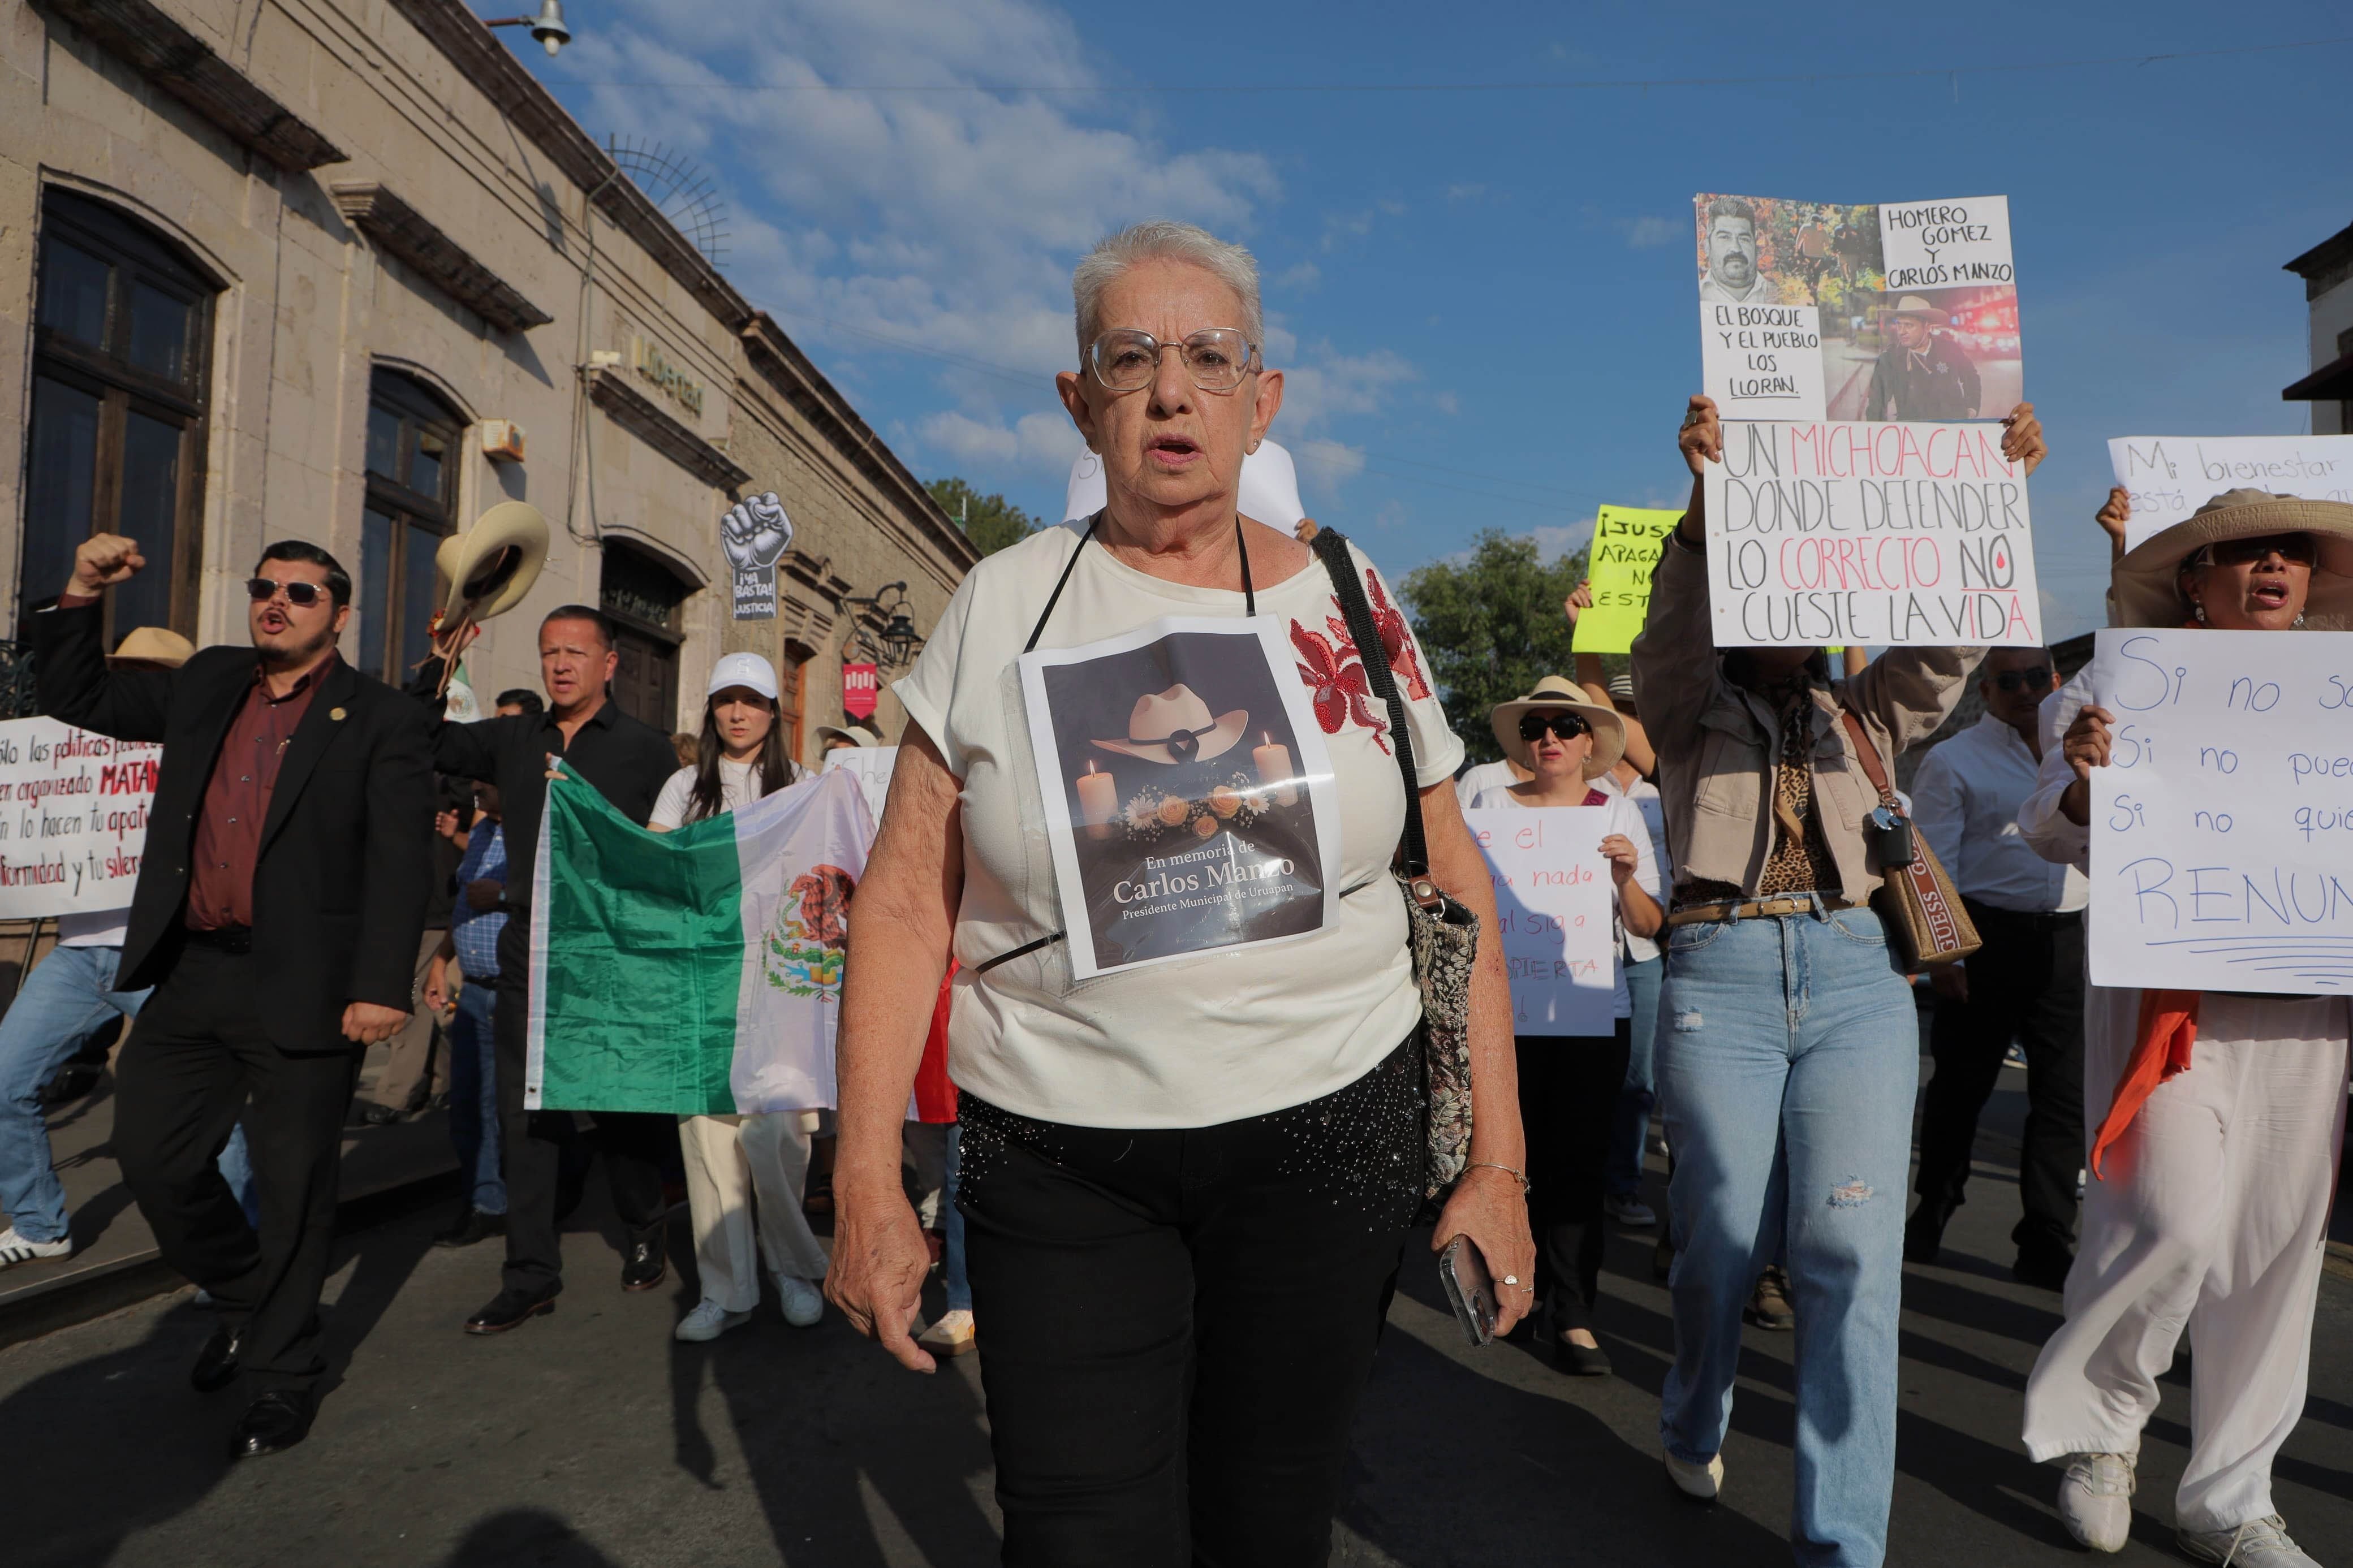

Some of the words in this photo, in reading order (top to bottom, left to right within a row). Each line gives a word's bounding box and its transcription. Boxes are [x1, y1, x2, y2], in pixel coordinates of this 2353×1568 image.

[1889, 206, 1967, 230] HOMERO
[1922, 225, 1992, 245] GOMEZ
[1925, 248, 1940, 264] Y
[1889, 265, 1947, 288] CARLOS
[1954, 262, 2012, 282] MANZO
[1716, 305, 1734, 326] EL
[1738, 307, 1803, 328] BOSQUE
[1719, 332, 1732, 349] Y
[1738, 331, 1759, 348] EL
[1764, 332, 1818, 348] PUEBLO
[1748, 353, 1777, 373] LOS
[1730, 374, 1799, 396] LLORAN.
[1722, 423, 1779, 478] UN
[1791, 425, 2014, 478] MICHOACAN
[2127, 441, 2177, 480] Mi
[2196, 443, 2341, 481] bienestar
[1725, 478, 1850, 533] DONDE
[1860, 478, 2024, 532] DEFENDER
[1727, 539, 1766, 590] LO
[1780, 537, 1941, 590] CORRECTO
[1959, 533, 2014, 589] NO
[735, 582, 772, 598] BASTA!
[736, 602, 774, 614] JUSTICIA
[1743, 591, 1870, 641] CUESTE
[1889, 592, 1937, 641] LA
[1939, 594, 2033, 641] VIDA
[2115, 636, 2187, 711] Si
[2227, 676, 2280, 712] no
[29, 735, 50, 762] las
[2112, 725, 2152, 768] Si
[2201, 747, 2238, 774] no
[2288, 754, 2353, 785] pue
[18, 764, 92, 808] organizado
[19, 808, 33, 838] lo
[41, 808, 81, 839] hacen
[89, 801, 104, 832] tu
[2109, 794, 2145, 832] Si
[2194, 810, 2233, 833] no
[1515, 819, 1542, 849] el
[1145, 856, 1166, 870] En
[1170, 843, 1235, 866] memoria
[1238, 840, 1255, 853] de
[72, 861, 82, 896] y
[88, 850, 104, 880] tu
[1114, 871, 1199, 904] Carlos
[1533, 864, 1593, 887] nada
[1122, 900, 1177, 920] Presidente
[1179, 892, 1232, 909] Municipal
[1235, 889, 1247, 900] de
[1249, 884, 1294, 897] Uruapan
[1922, 890, 1956, 953] GUESS
